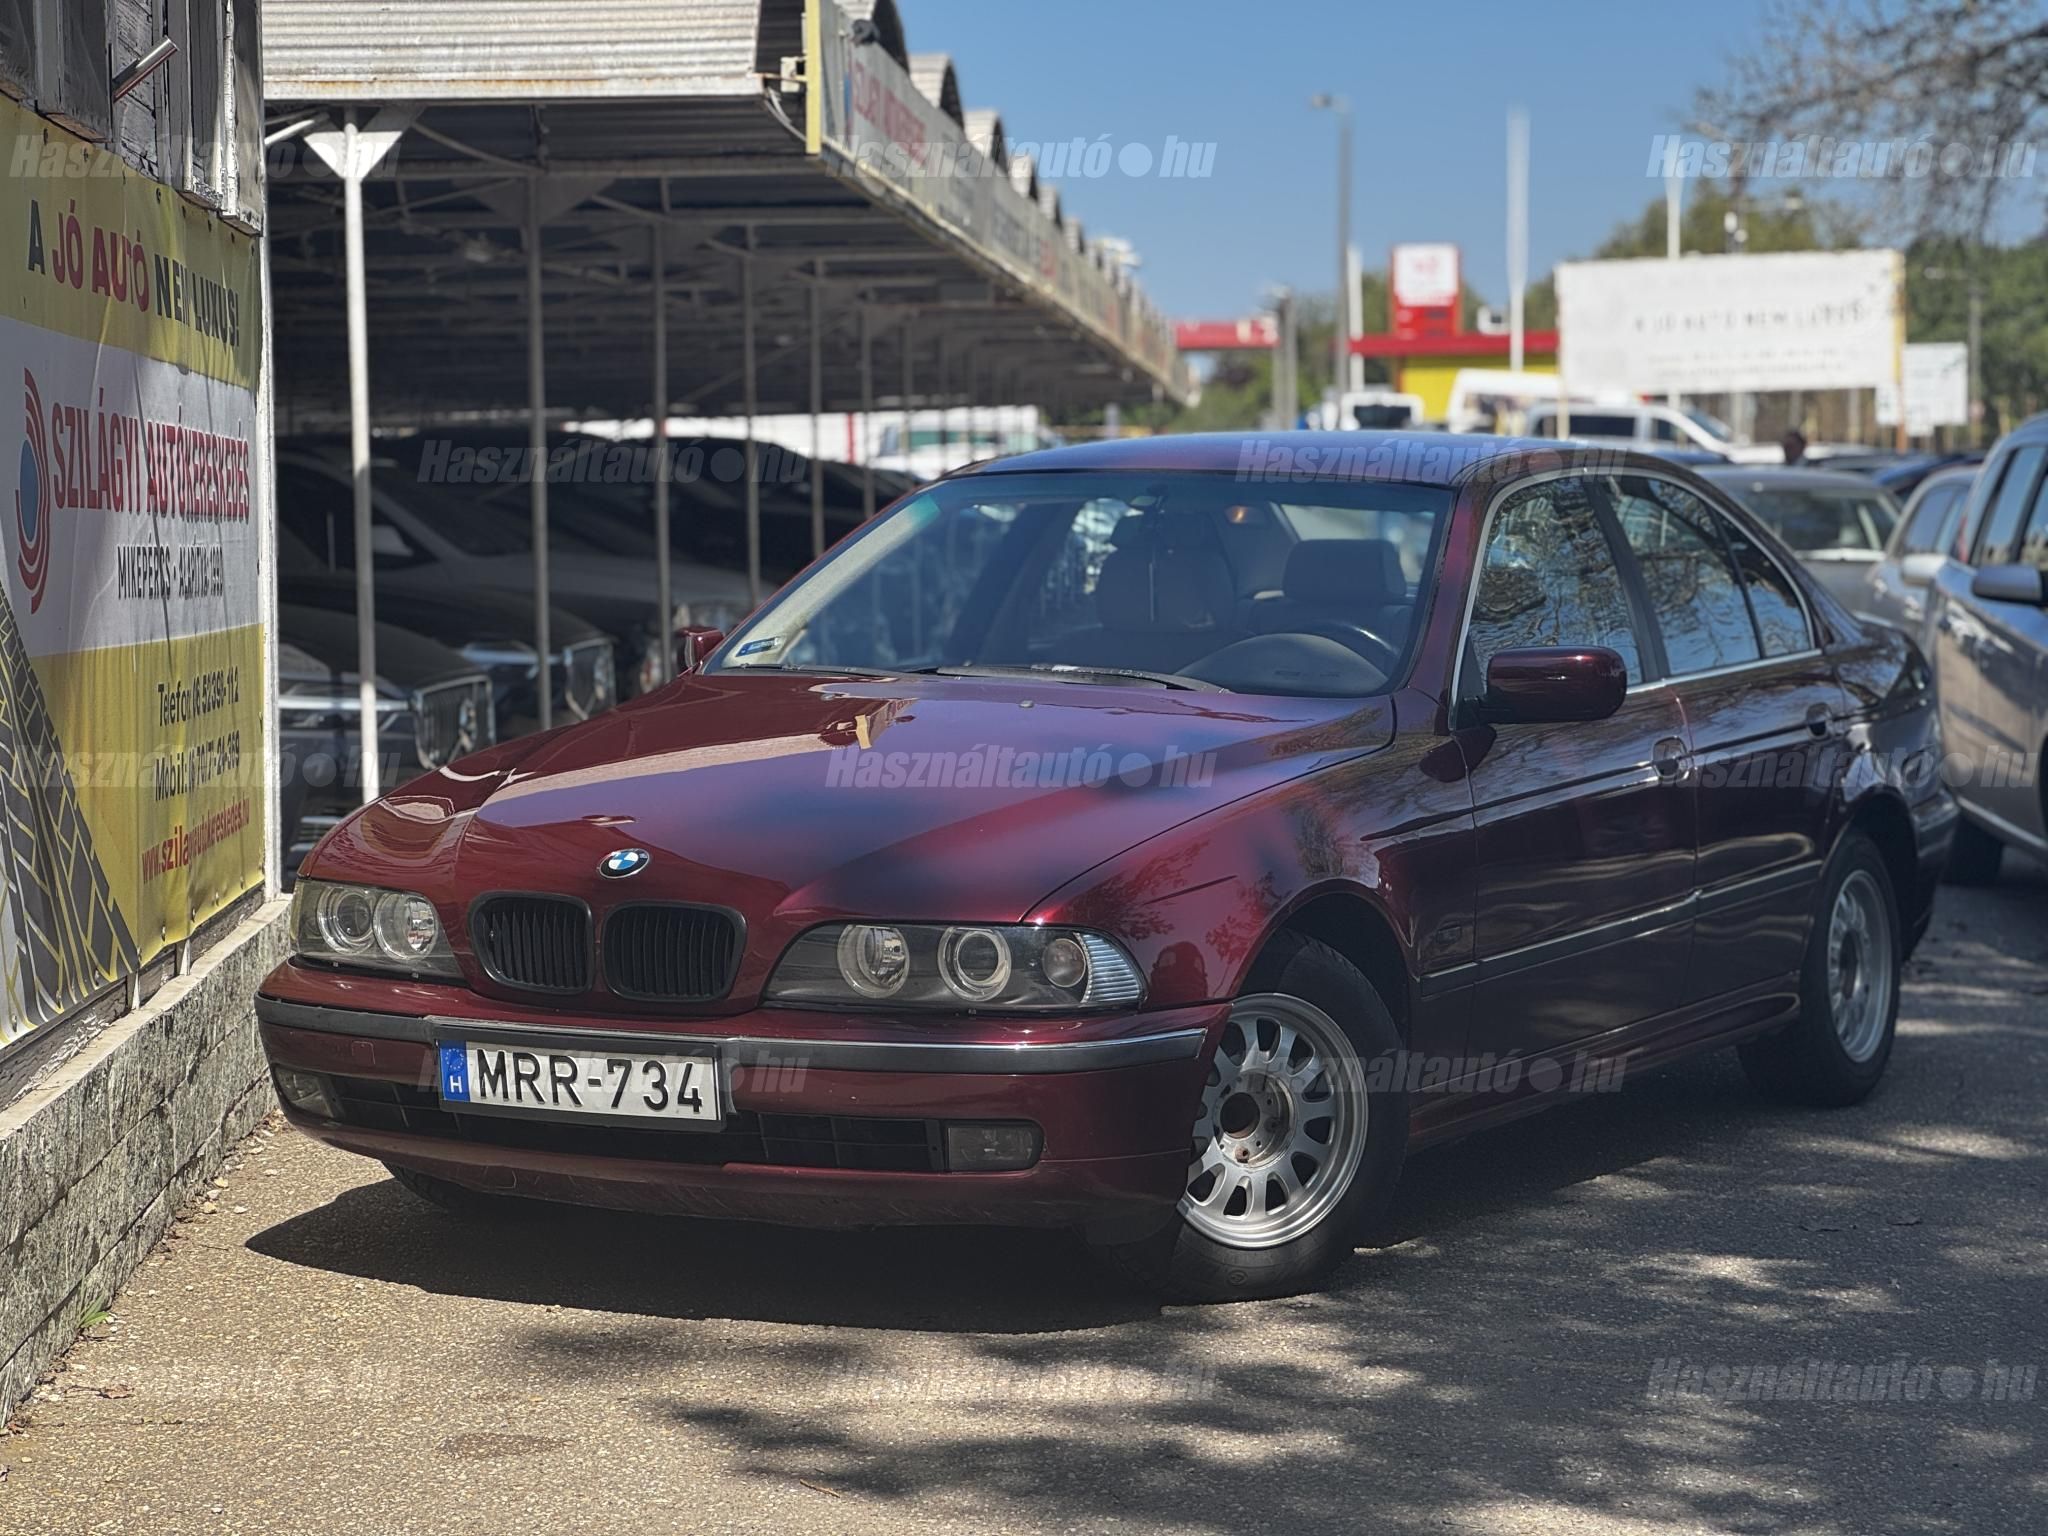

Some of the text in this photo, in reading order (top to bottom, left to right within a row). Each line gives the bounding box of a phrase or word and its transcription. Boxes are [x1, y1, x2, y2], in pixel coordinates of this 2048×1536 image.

[28, 199, 46, 275] A
[52, 199, 84, 289] JÓ
[92, 229, 149, 312] AUTÓ
[192, 272, 240, 347] LUXUS!
[51, 387, 250, 525] SZILÁGYI AUTÓKERESKEDÉS
[117, 532, 171, 601] MIKEPÉRCS
[155, 751, 187, 801] Mobil:
[449, 1048, 703, 1114] H MRR-734
